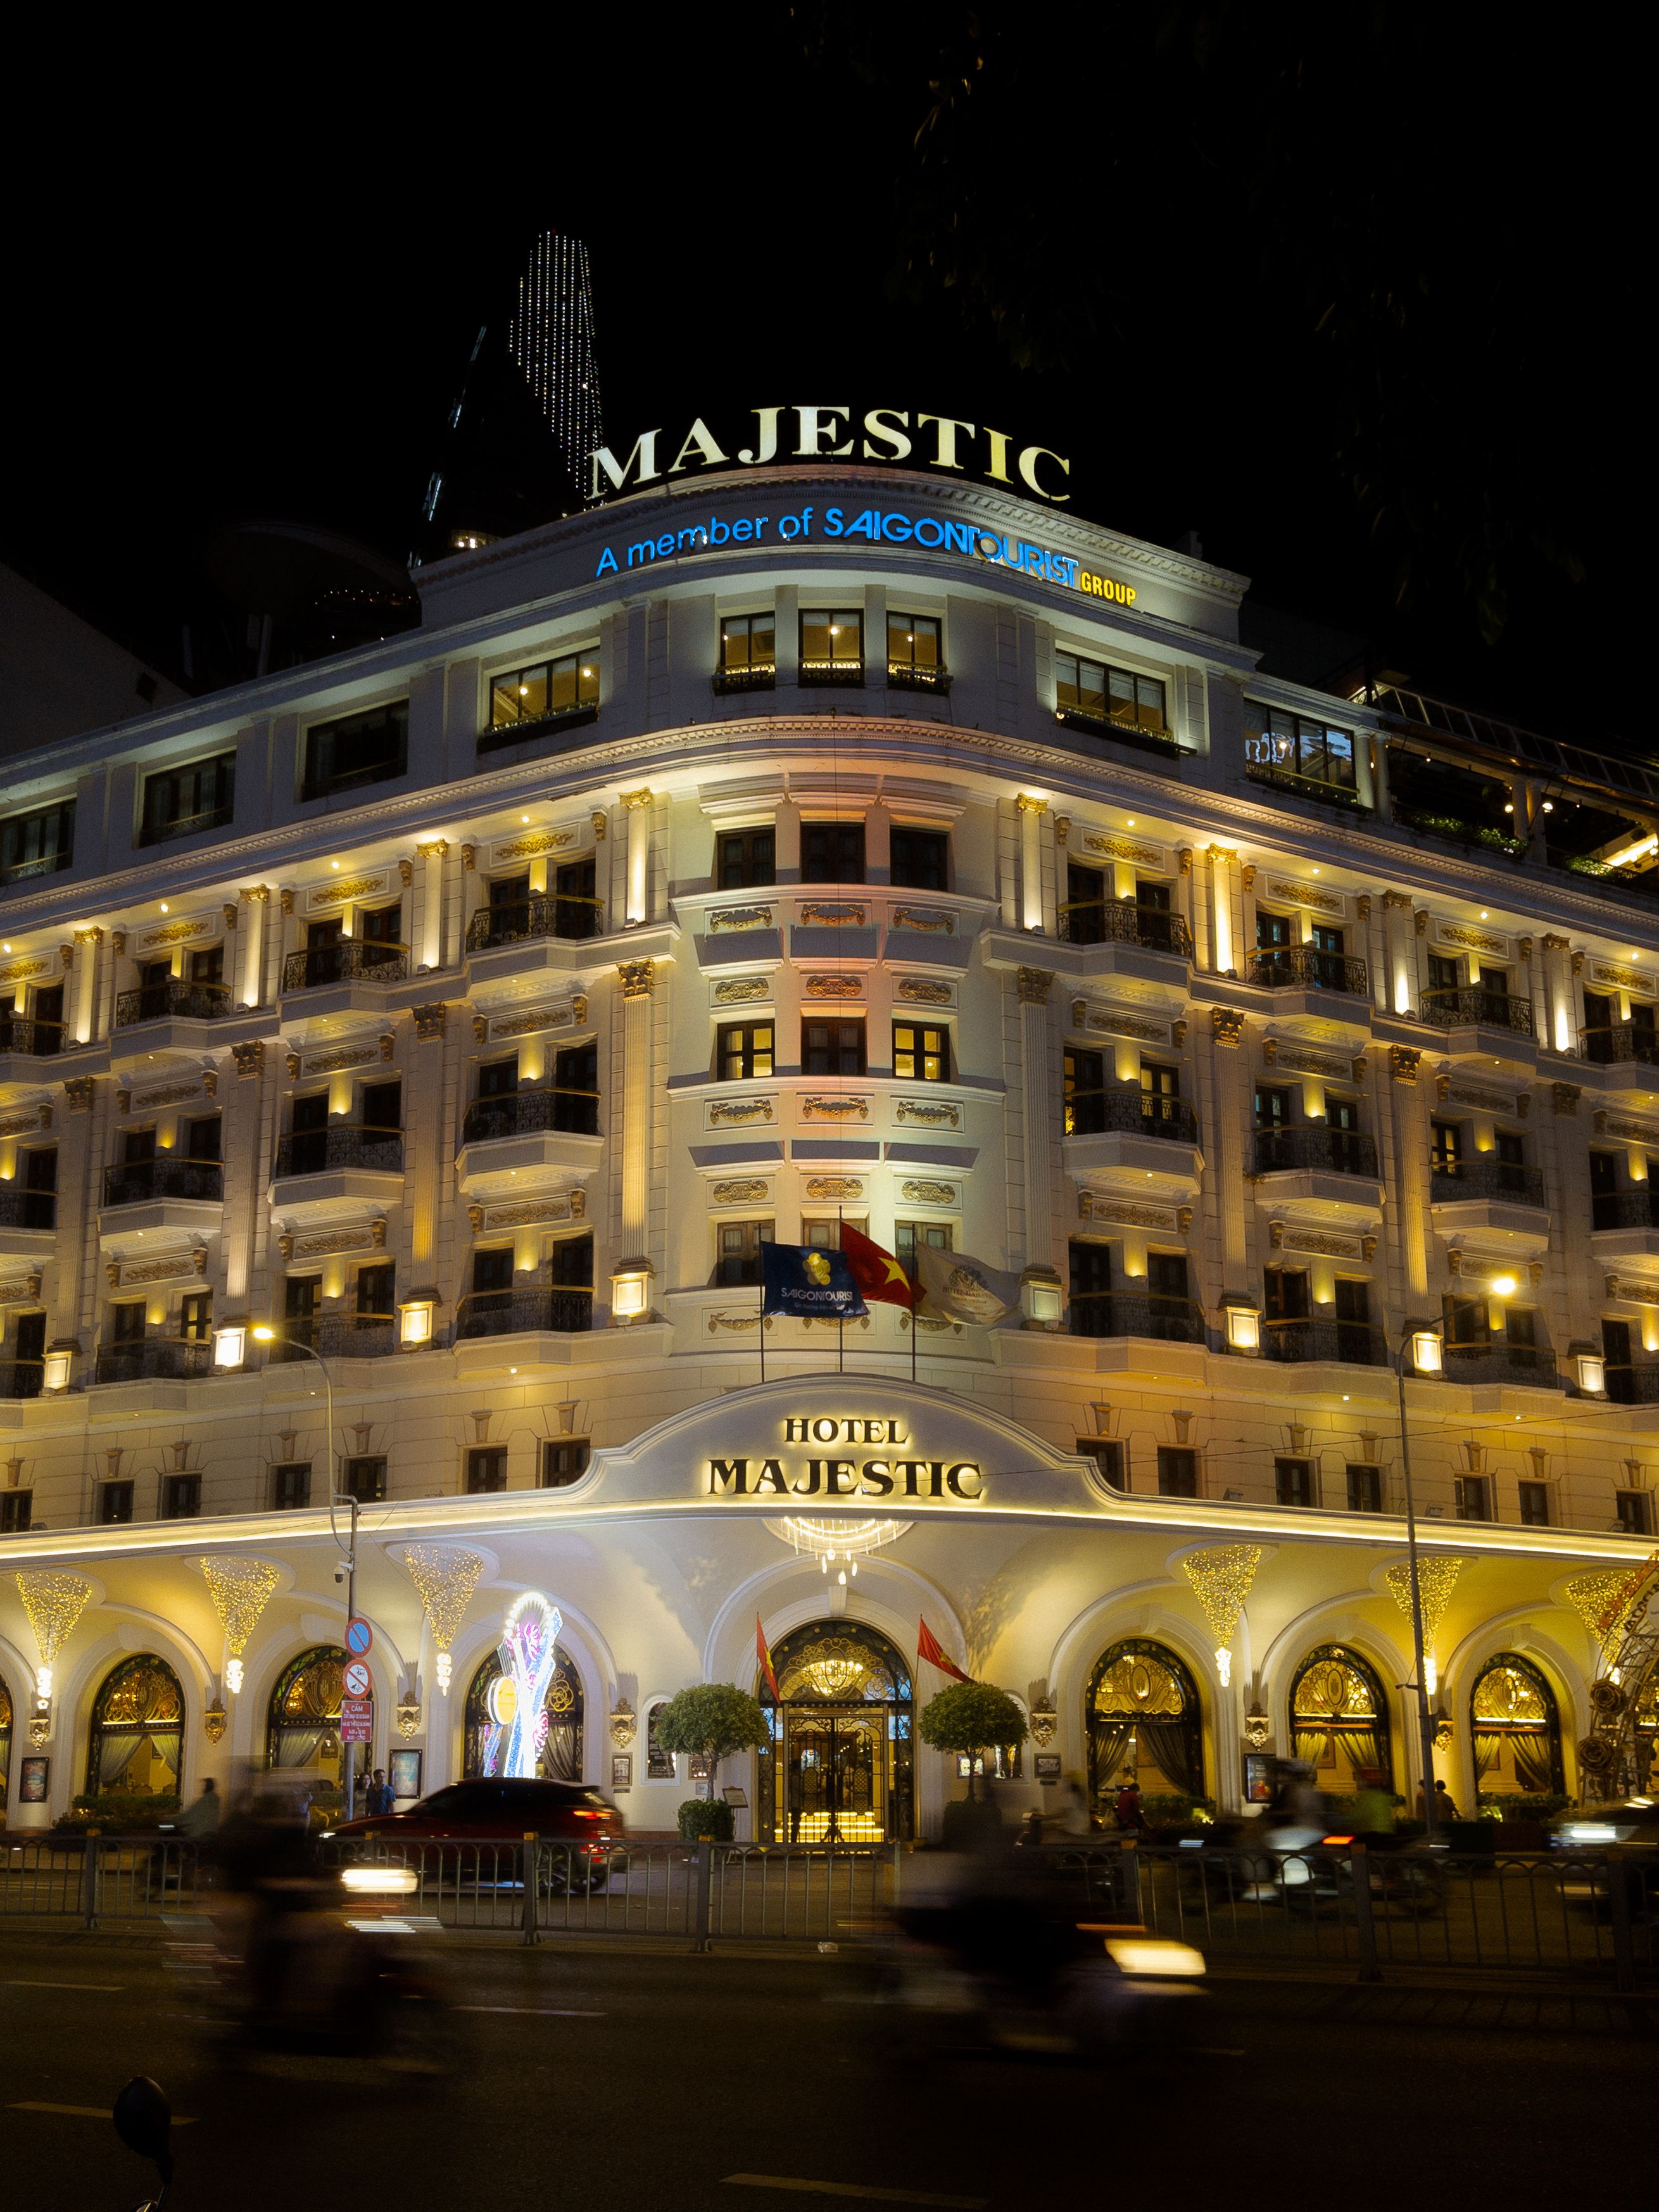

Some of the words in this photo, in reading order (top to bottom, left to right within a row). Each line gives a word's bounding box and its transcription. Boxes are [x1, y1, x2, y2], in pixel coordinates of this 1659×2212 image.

[586, 406, 1071, 502] MAJESTIC
[596, 547, 620, 578] A
[628, 517, 768, 567] member
[779, 507, 814, 540] of
[824, 508, 1080, 587] SAIGONTOURIST
[1081, 572, 1137, 607] GROUP
[781, 1287, 854, 1302] SAIGONTOURIST
[784, 1418, 909, 1444] HOTEL
[707, 1458, 983, 1500] MAJESTIC
